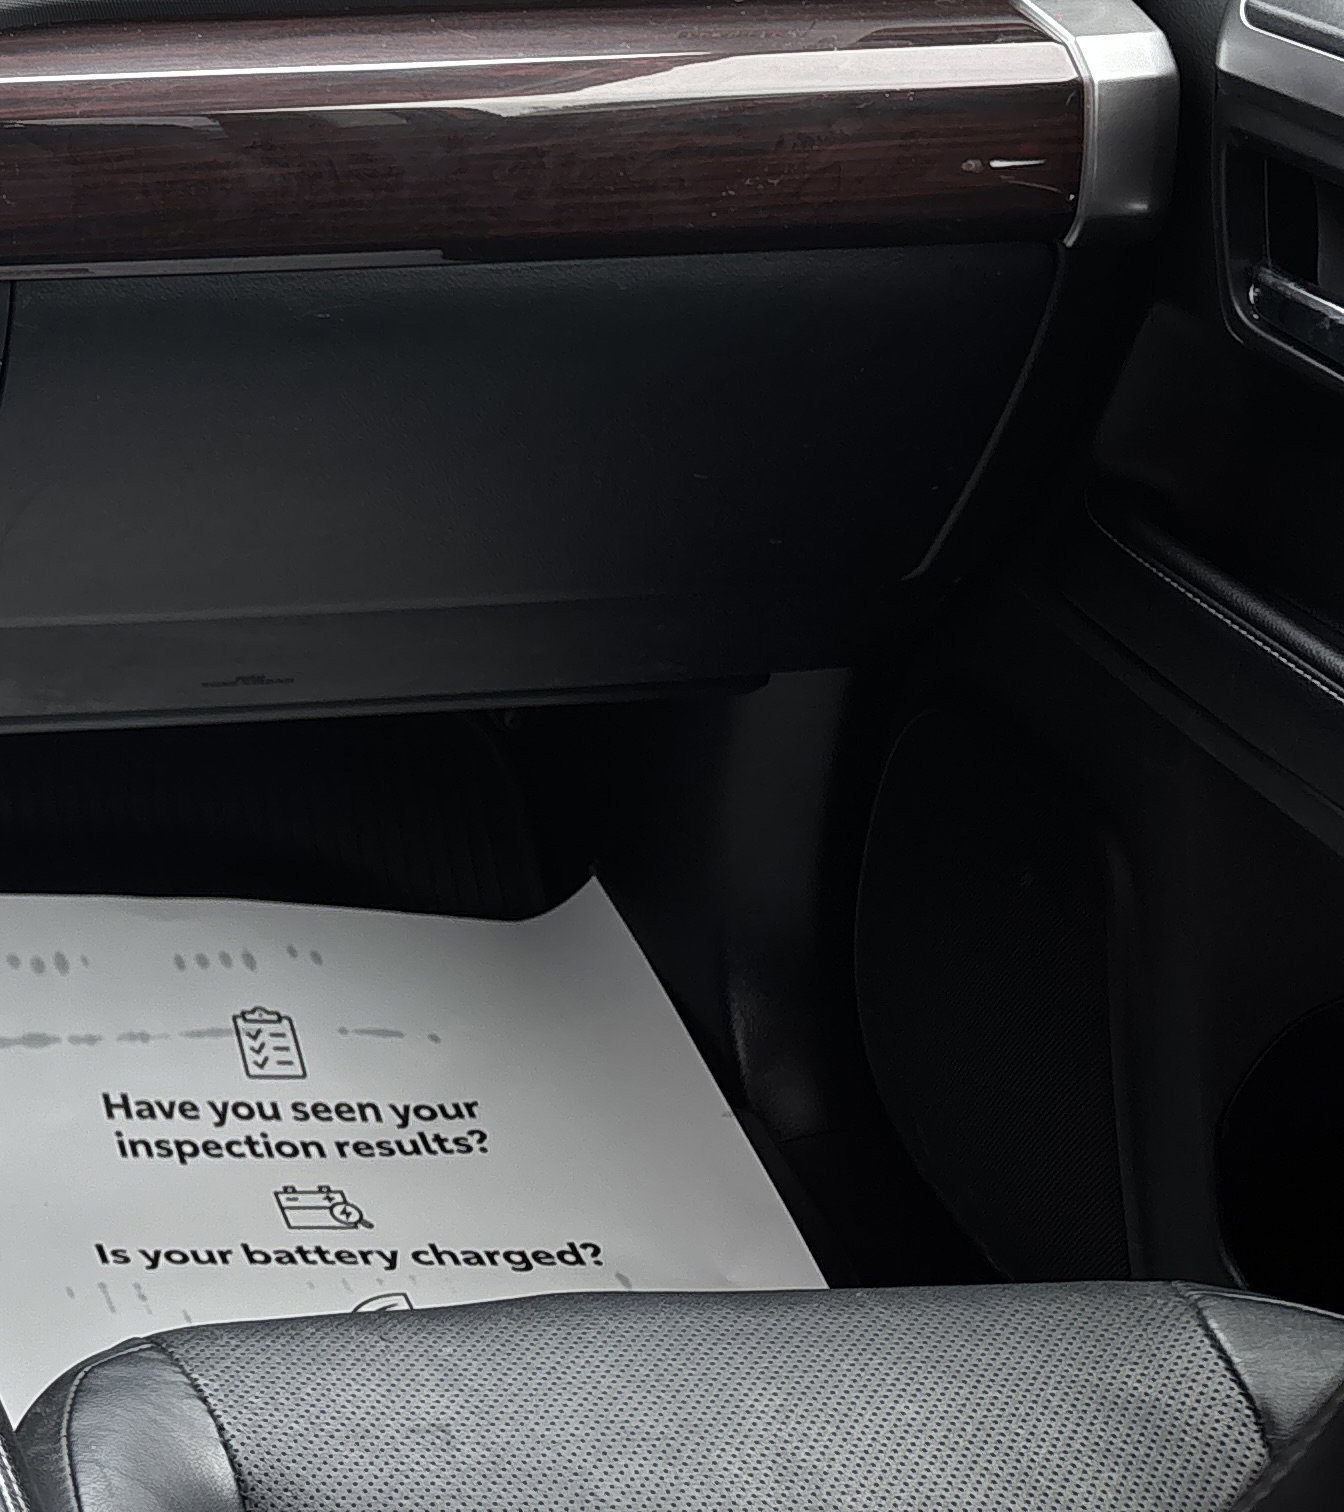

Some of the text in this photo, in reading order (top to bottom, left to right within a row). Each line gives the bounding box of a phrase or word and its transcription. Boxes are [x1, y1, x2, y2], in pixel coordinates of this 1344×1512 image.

[102, 1092, 480, 1129] Have you seen your
[115, 1129, 489, 1166] inspection results?
[95, 1241, 603, 1273] Is your battery charged?
